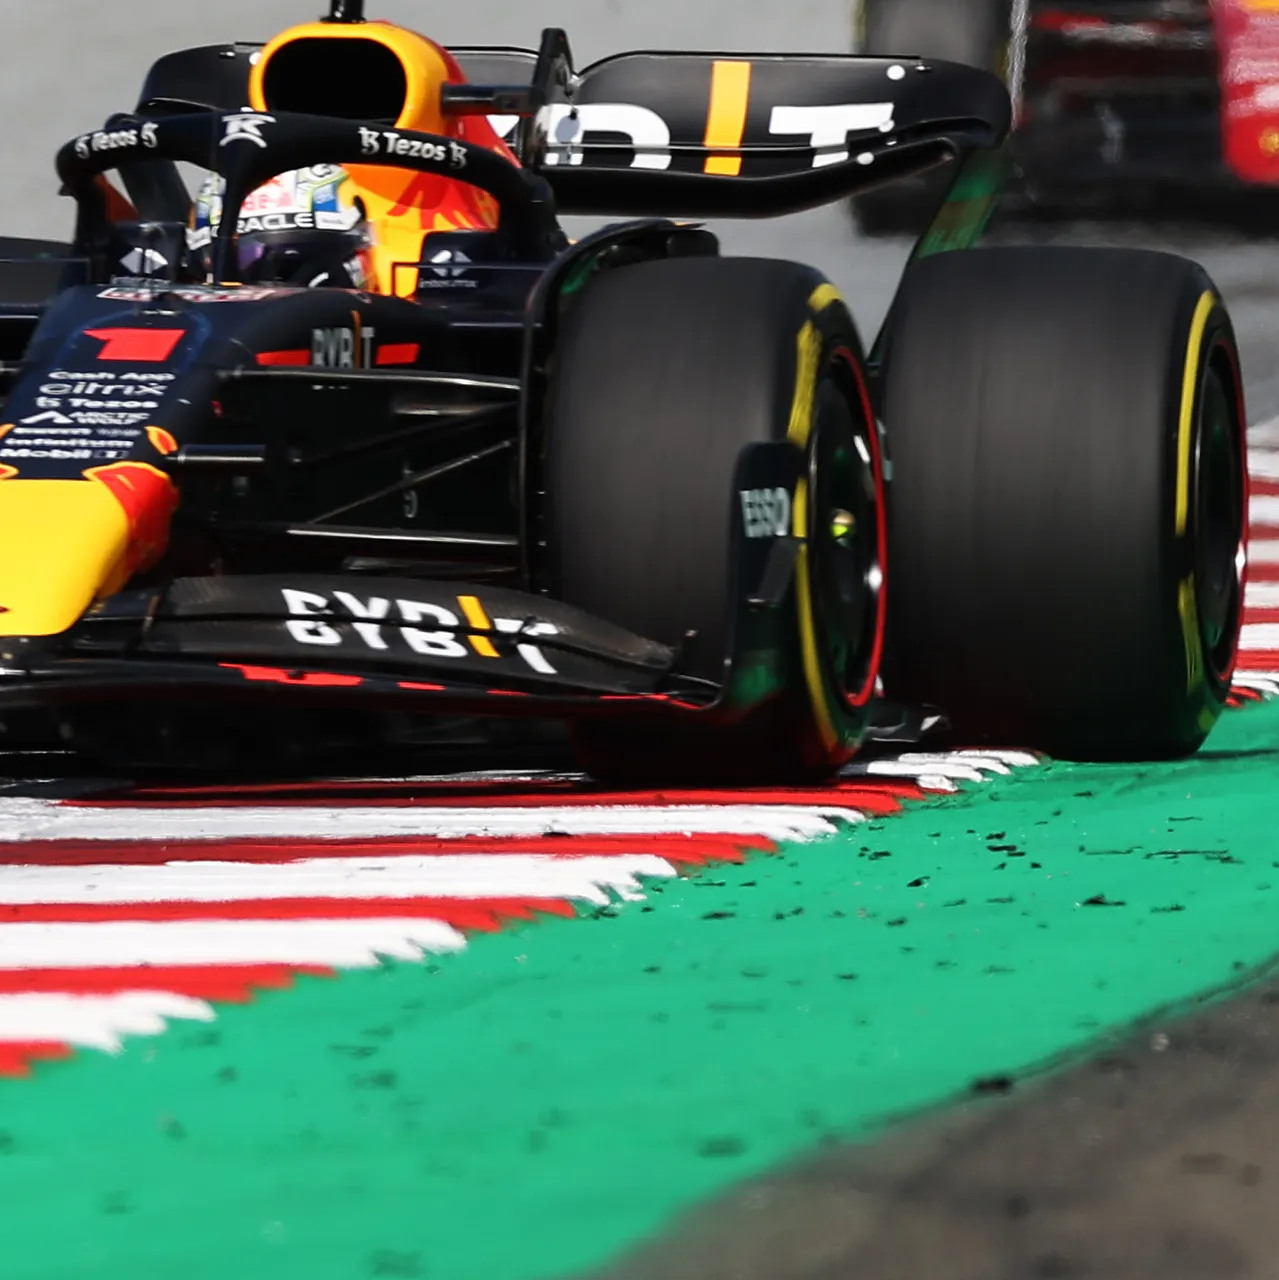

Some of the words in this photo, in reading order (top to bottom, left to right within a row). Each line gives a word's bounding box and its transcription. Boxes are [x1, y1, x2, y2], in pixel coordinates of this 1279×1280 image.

[383, 131, 447, 161] Tezos
[235, 212, 314, 234] RACLE
[83, 327, 186, 362] 1
[48, 371, 116, 380] Cash
[119, 372, 176, 381] App
[69, 398, 159, 409] Tezos
[281, 588, 559, 674] BYBIT
